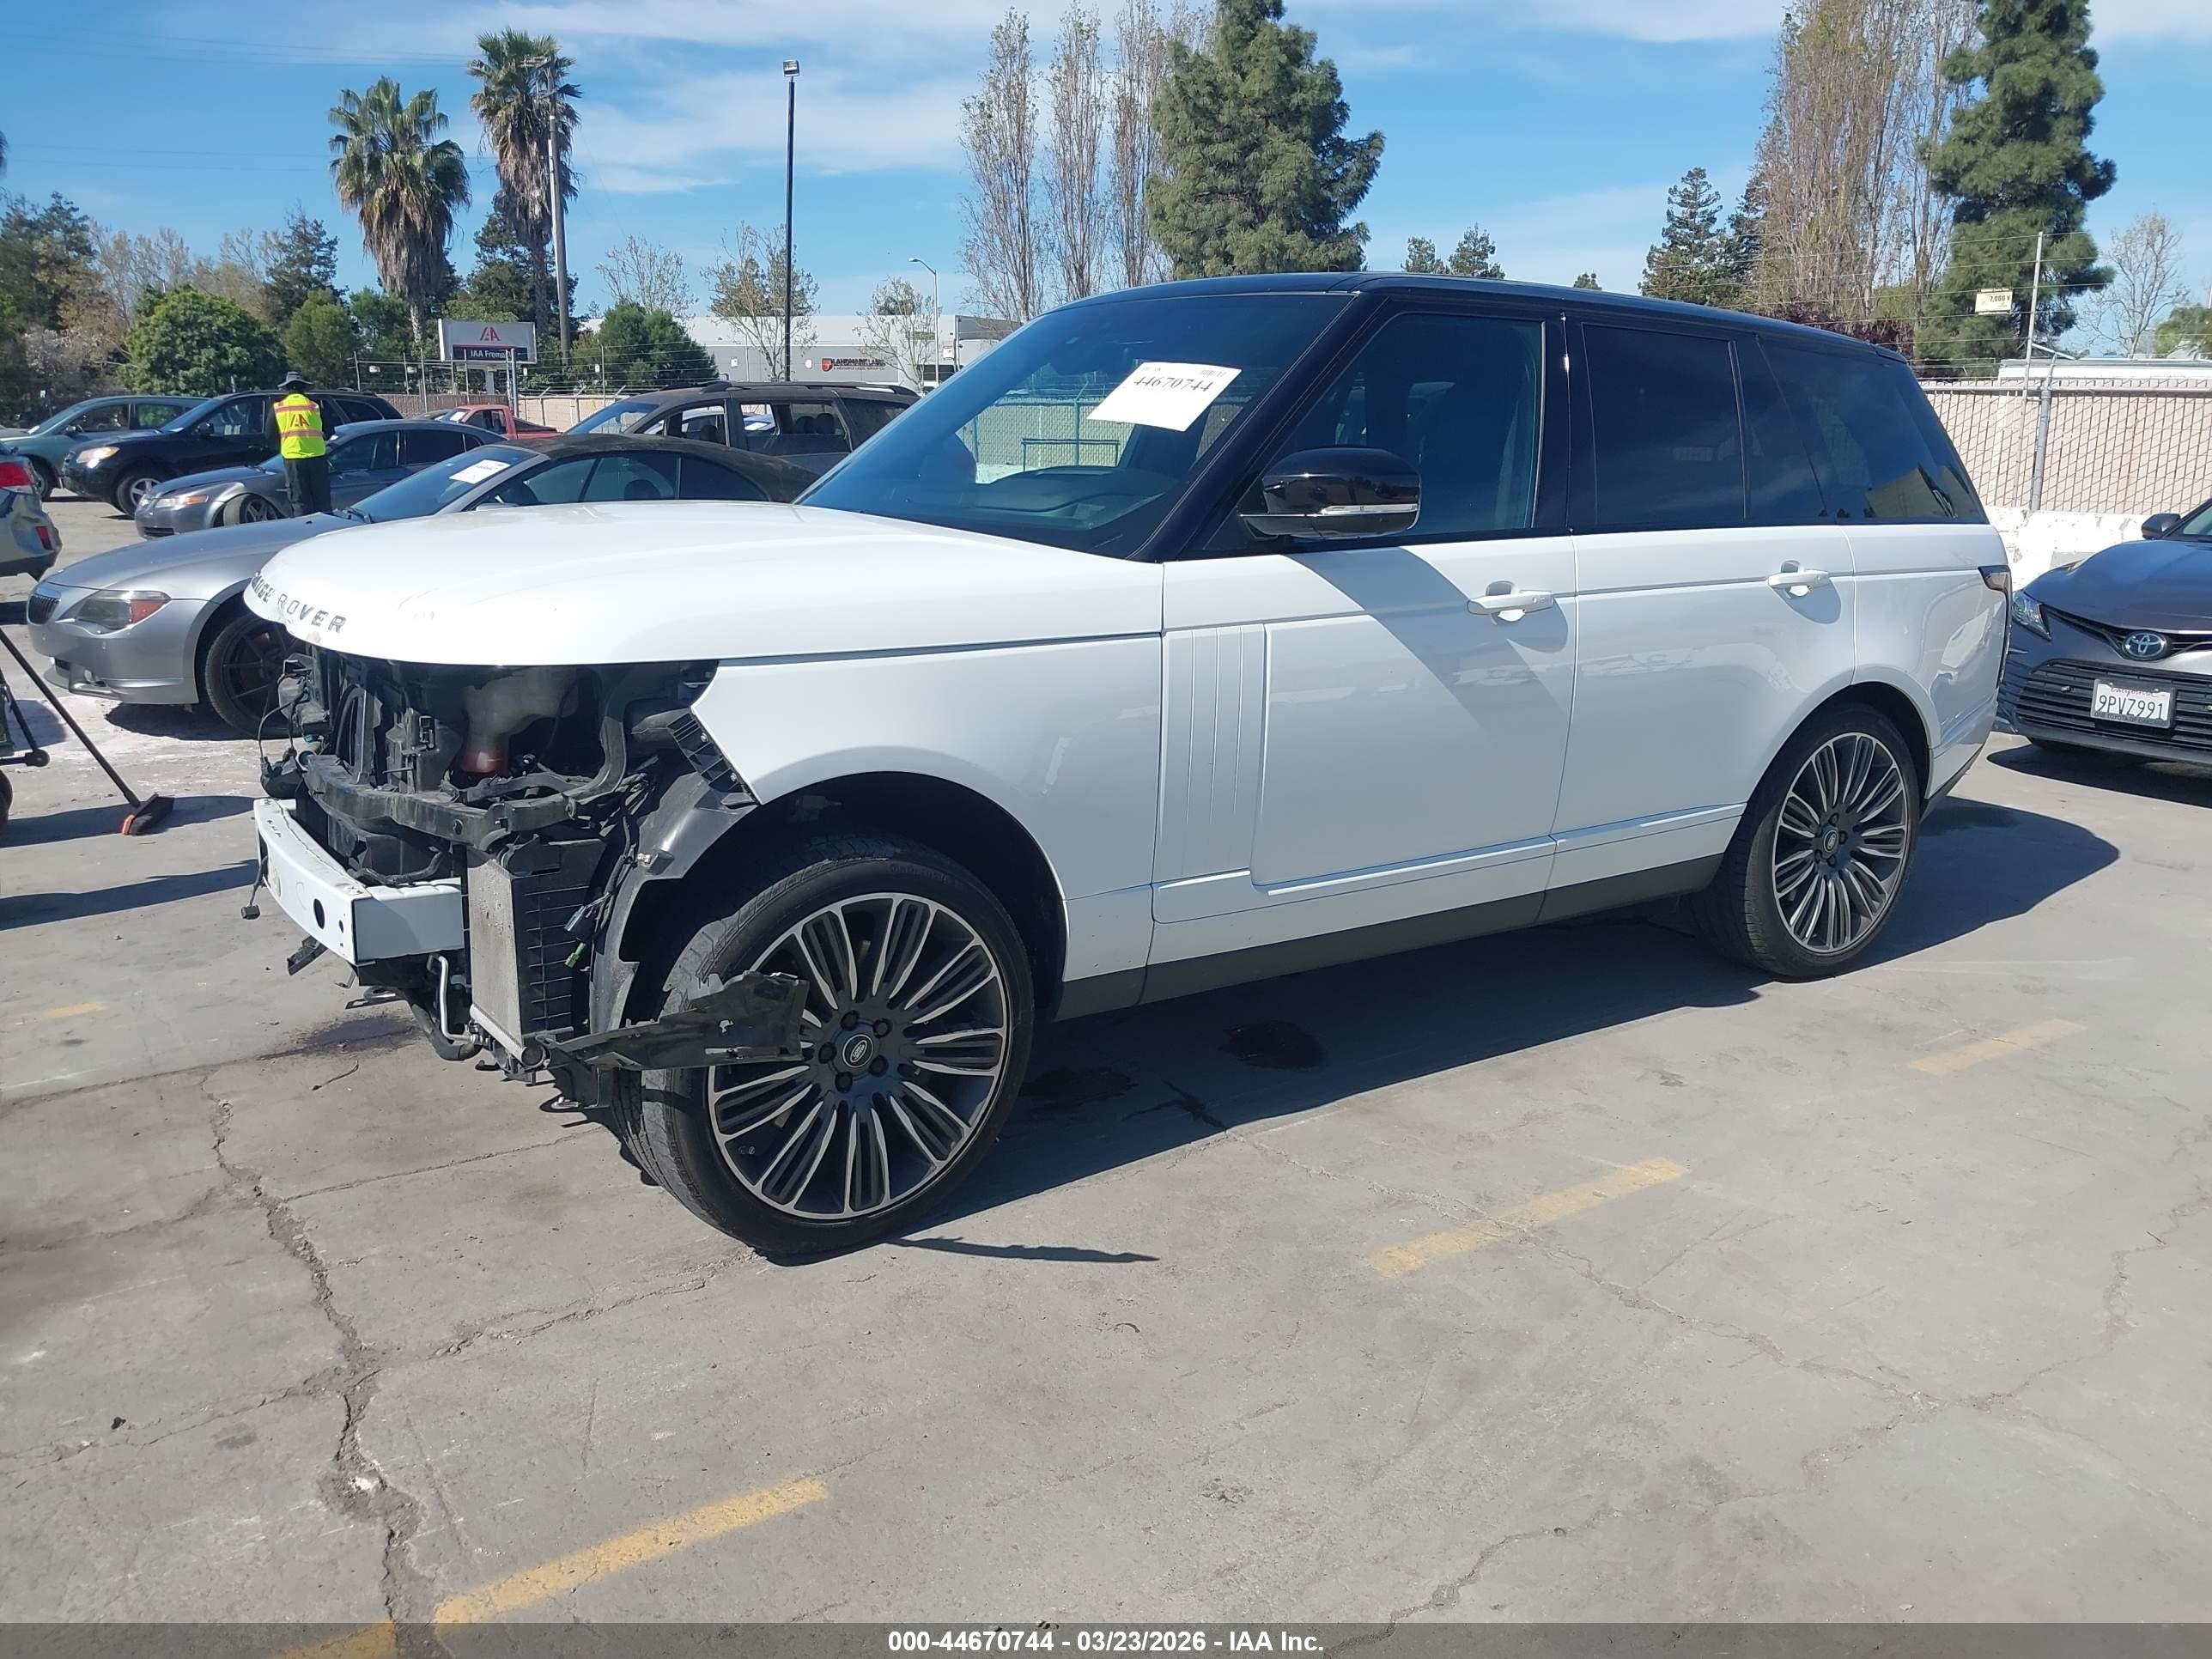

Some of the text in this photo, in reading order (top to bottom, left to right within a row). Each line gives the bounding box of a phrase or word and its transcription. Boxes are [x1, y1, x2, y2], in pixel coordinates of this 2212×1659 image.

[1133, 376, 1213, 392] 44670744
[277, 593, 347, 633] ROVER
[2095, 695, 2163, 720] 9PVZ991
